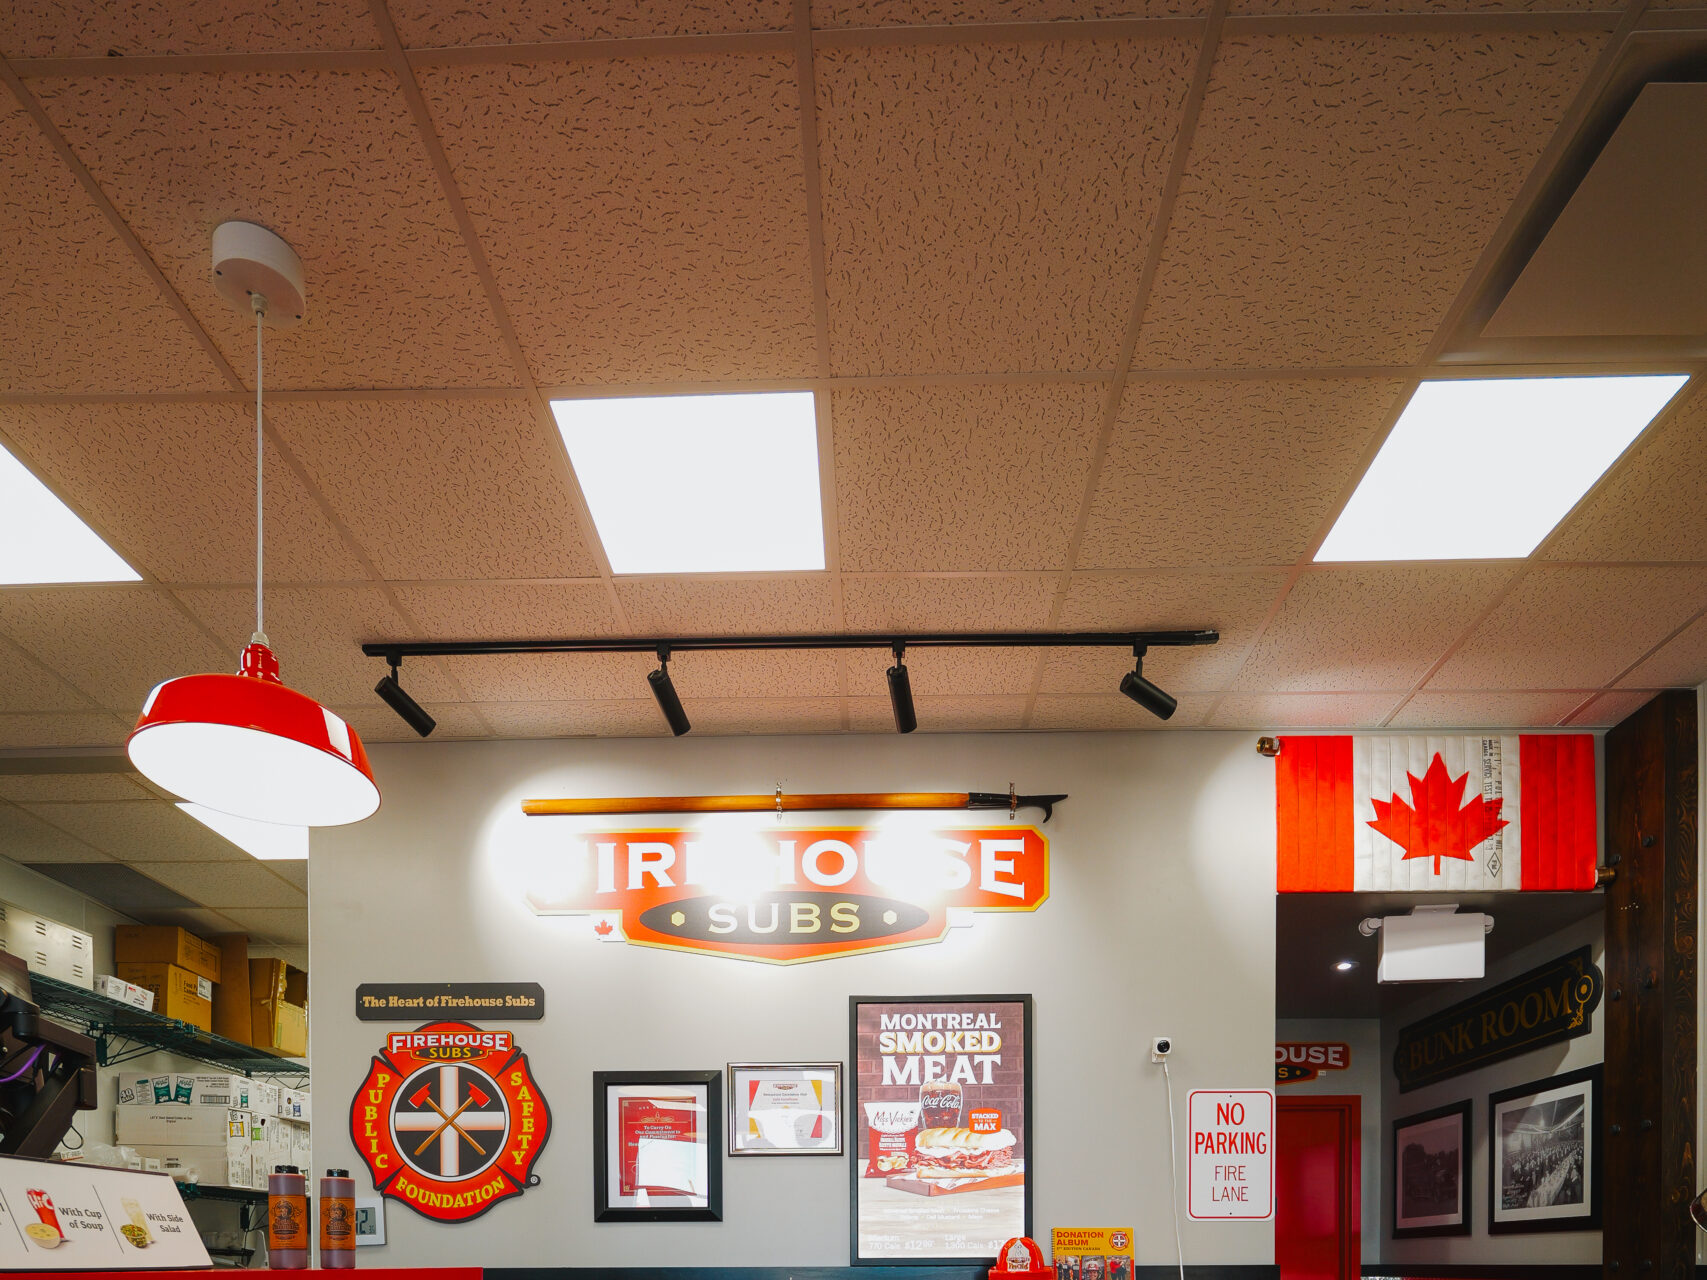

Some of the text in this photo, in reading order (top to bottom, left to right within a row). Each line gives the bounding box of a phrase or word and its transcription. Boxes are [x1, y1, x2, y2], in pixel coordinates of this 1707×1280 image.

[707, 901, 861, 934] SUBS
[363, 995, 536, 1007] The Heart of Firehouse Subs
[880, 1013, 1001, 1030] MONTREAL
[1409, 977, 1572, 1072] BUNK ROOM
[392, 1033, 508, 1054] FIREHOUSE
[879, 1031, 1002, 1054] SMOKED
[429, 1047, 472, 1058] SUBS
[881, 1054, 1001, 1085] MEAT
[364, 1073, 391, 1169] PUBLIC
[510, 1072, 535, 1165] SAFETY
[1216, 1103, 1245, 1126] NO
[974, 1122, 997, 1131] MAX
[1194, 1132, 1267, 1155] PARKING
[1214, 1165, 1246, 1181] FIRE
[395, 1175, 506, 1208] FOUNDATION
[1212, 1187, 1249, 1203] LANE
[59, 1207, 103, 1219] With Cup
[147, 1212, 184, 1223] With Side
[69, 1219, 104, 1231] of Soup
[159, 1224, 181, 1233] Salad
[1056, 1231, 1104, 1239] DONATION
